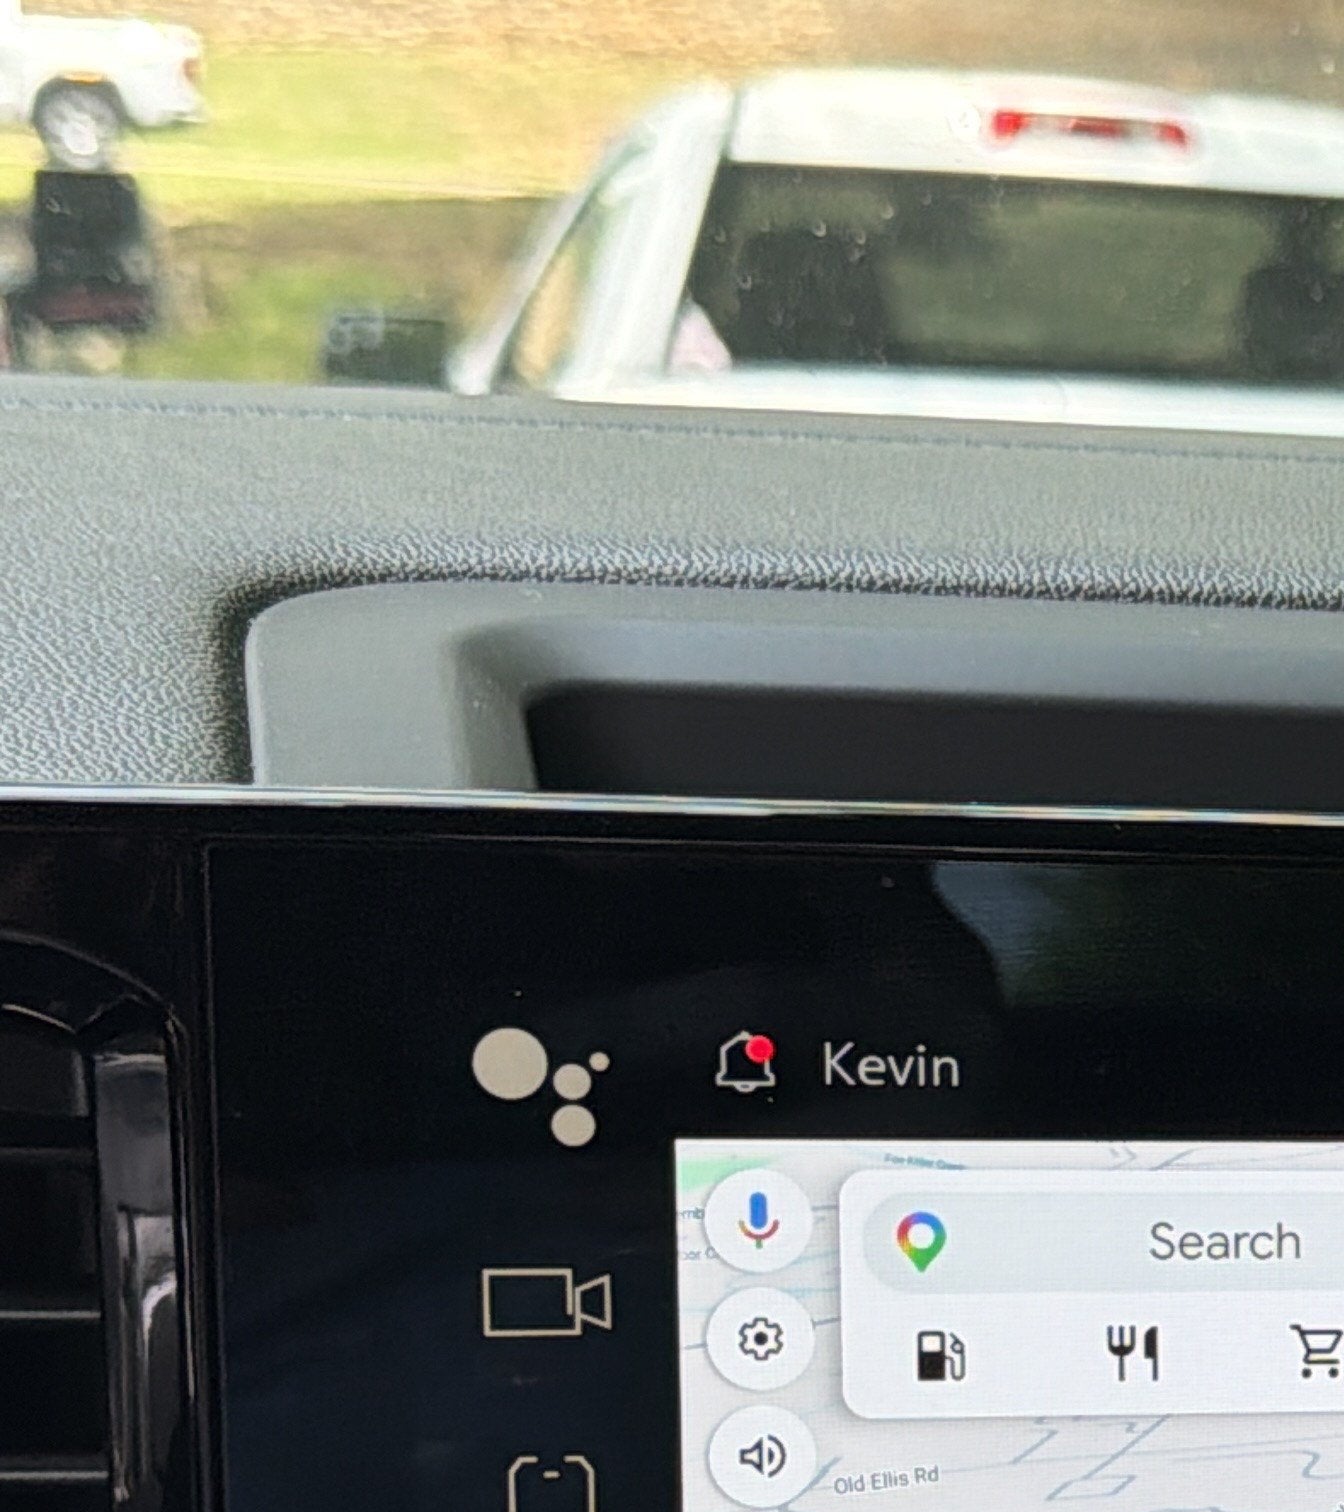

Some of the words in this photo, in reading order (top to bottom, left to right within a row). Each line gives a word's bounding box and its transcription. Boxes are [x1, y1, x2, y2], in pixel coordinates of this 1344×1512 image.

[823, 1041, 961, 1088] Kevin
[1150, 1221, 1302, 1261] Search
[833, 1475, 866, 1496] Old
[871, 1469, 910, 1491] Ellis
[914, 1465, 941, 1485] Rd
